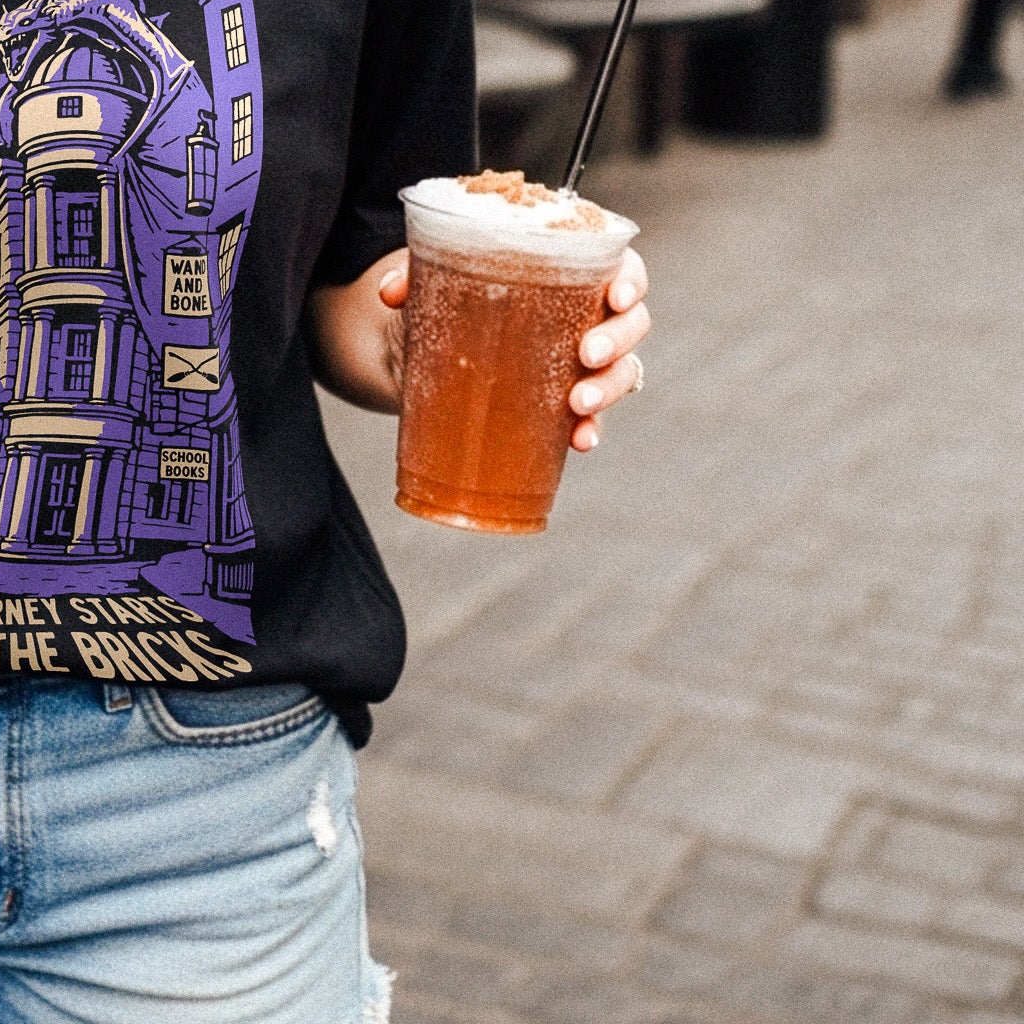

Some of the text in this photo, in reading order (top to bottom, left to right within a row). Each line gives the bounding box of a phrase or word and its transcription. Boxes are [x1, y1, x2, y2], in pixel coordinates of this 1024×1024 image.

[173, 277, 203, 293] AND
[170, 294, 208, 311] BONE
[162, 451, 209, 464] SCHOOL
[165, 465, 205, 478] BOOKS
[70, 595, 204, 624] STARTS
[72, 629, 253, 682] BRICKS
